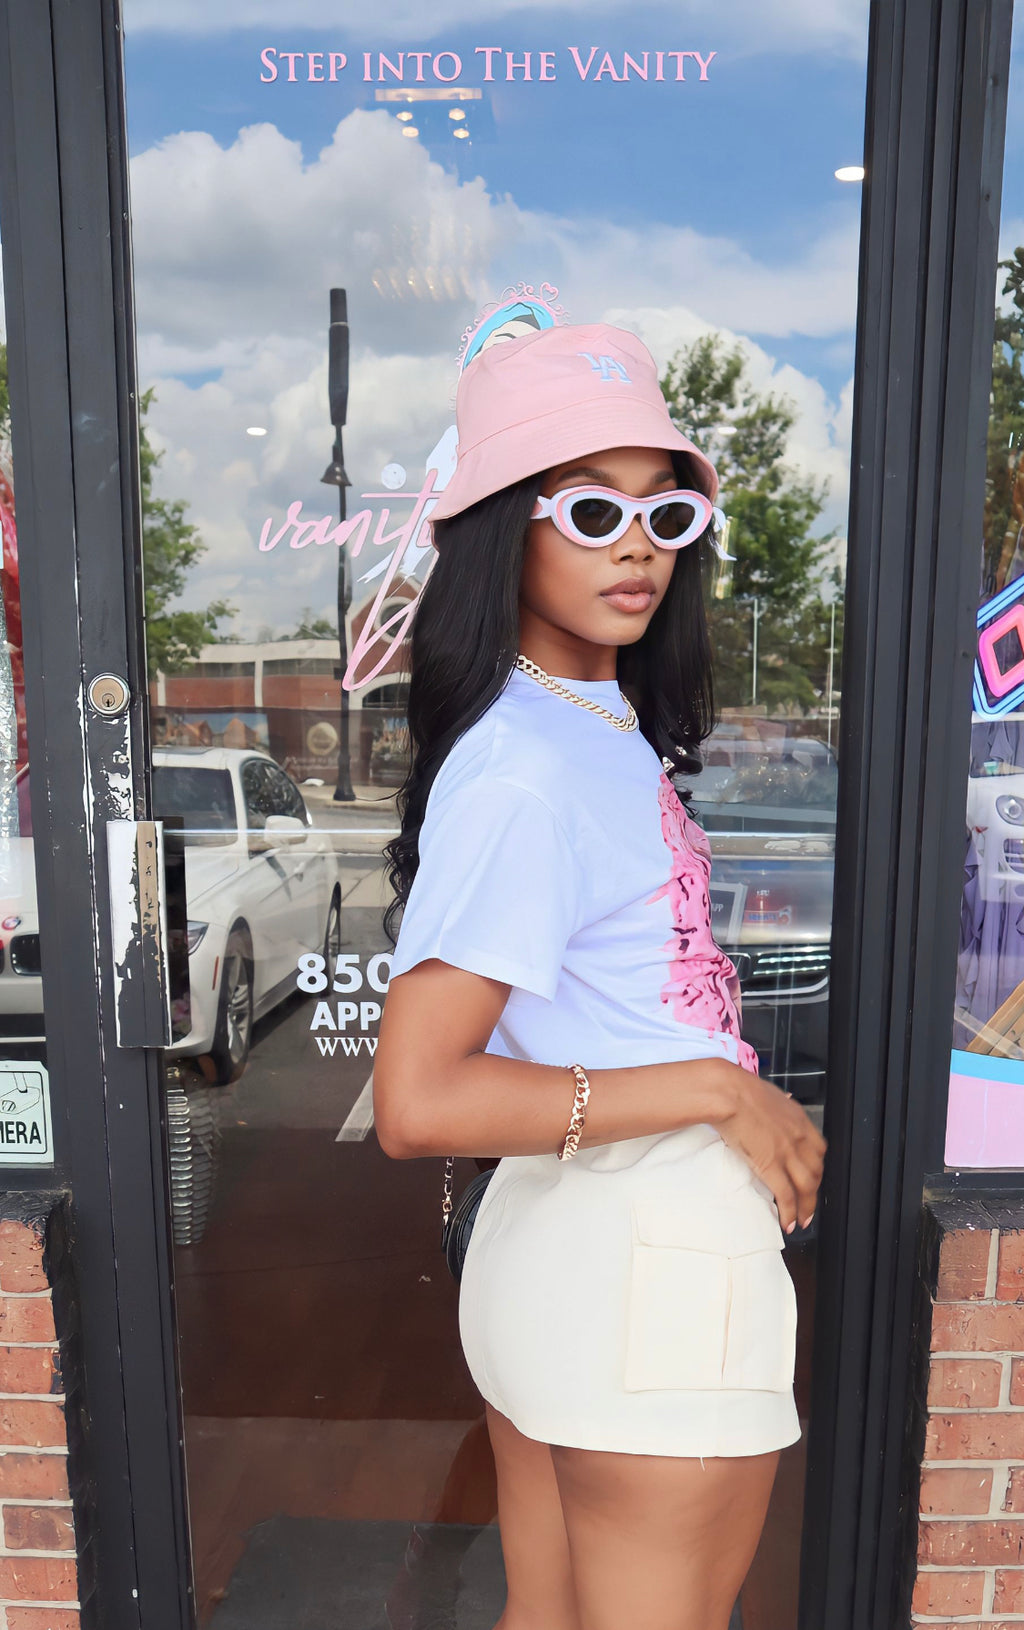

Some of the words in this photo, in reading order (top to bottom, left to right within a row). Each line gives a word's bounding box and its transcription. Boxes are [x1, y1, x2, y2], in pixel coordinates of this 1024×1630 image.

[260, 47, 347, 82] STEP
[475, 47, 556, 81] THE
[568, 46, 717, 82] VANITY
[296, 952, 394, 993] 850
[309, 1001, 385, 1031] APP
